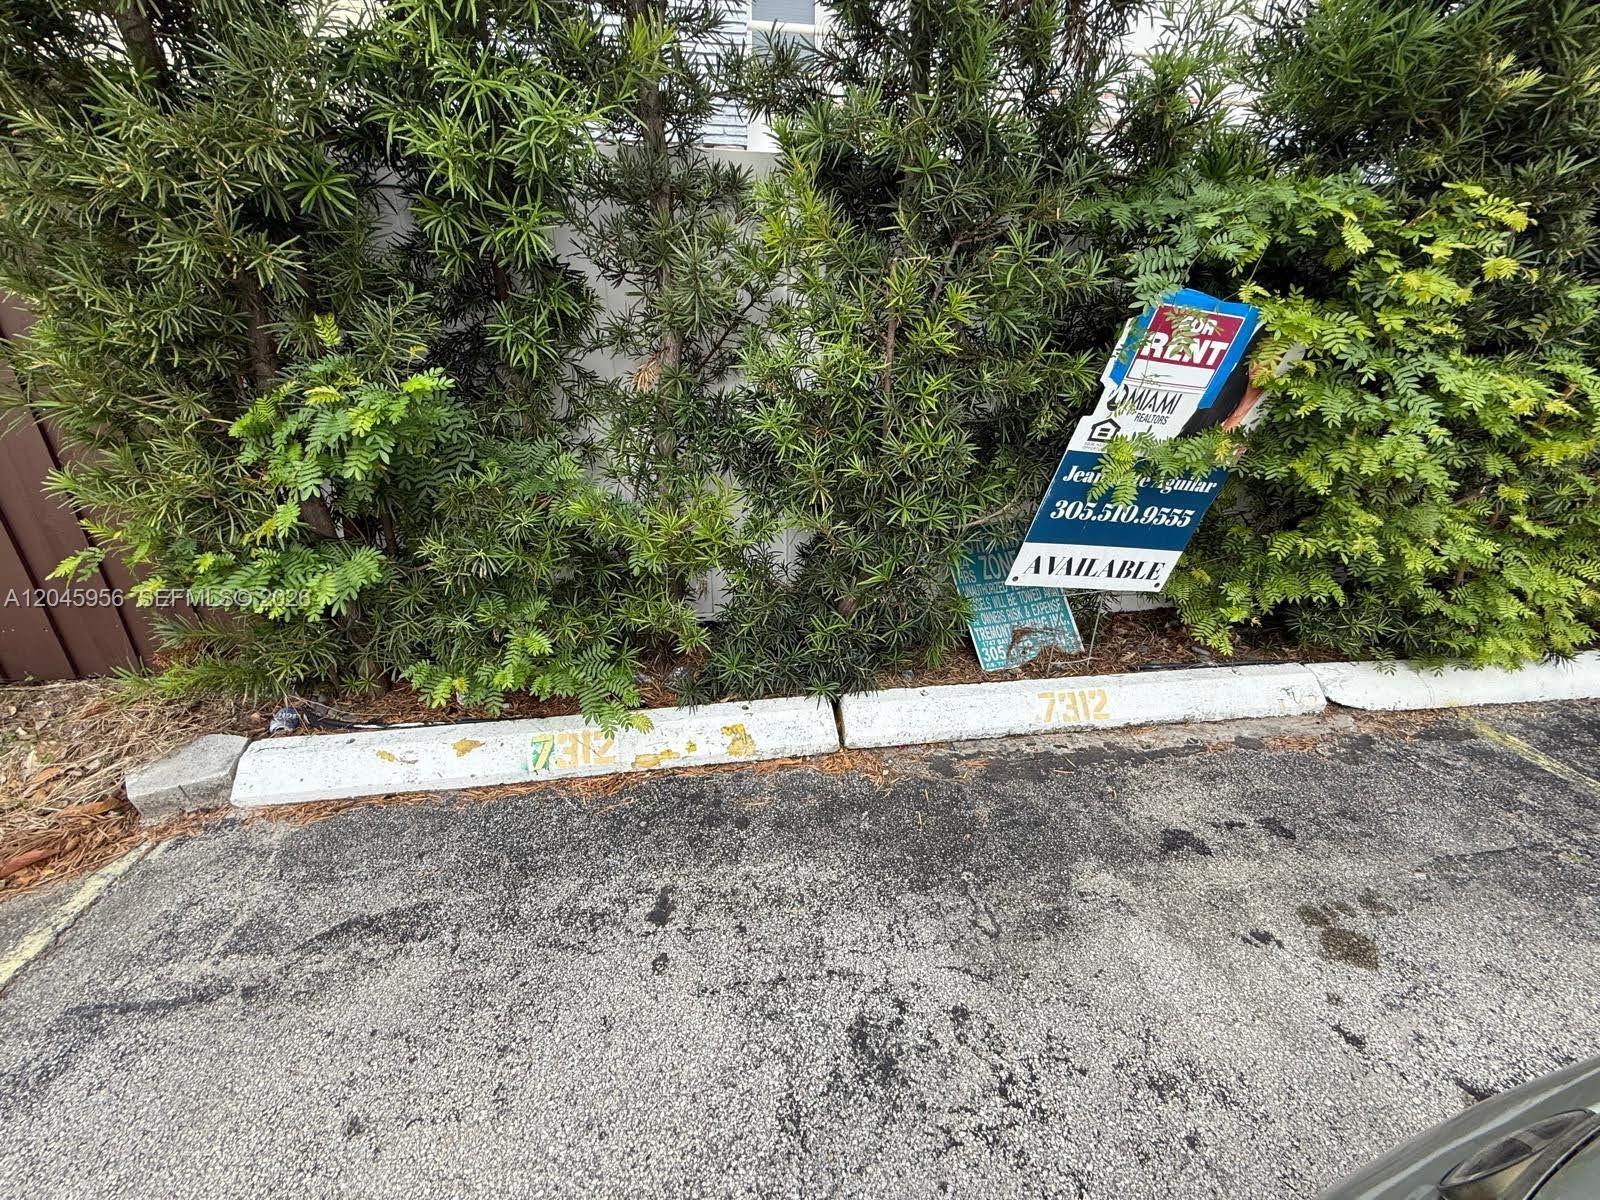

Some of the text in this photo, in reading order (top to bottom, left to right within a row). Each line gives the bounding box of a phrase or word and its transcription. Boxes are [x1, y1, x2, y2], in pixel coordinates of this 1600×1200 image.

[1129, 387, 1183, 415] MIAMI
[1050, 499, 1195, 528] 305.510.9555
[1022, 555, 1166, 581] AVAILABLE
[1006, 592, 1018, 607] BE
[1017, 588, 1041, 604] TOWED
[980, 609, 1007, 625] OWNERS
[1006, 605, 1024, 621] RISK
[973, 622, 1011, 642] TREMONT
[981, 645, 1007, 662] 305
[1037, 688, 1110, 724] 7312
[530, 730, 615, 772] 7312
